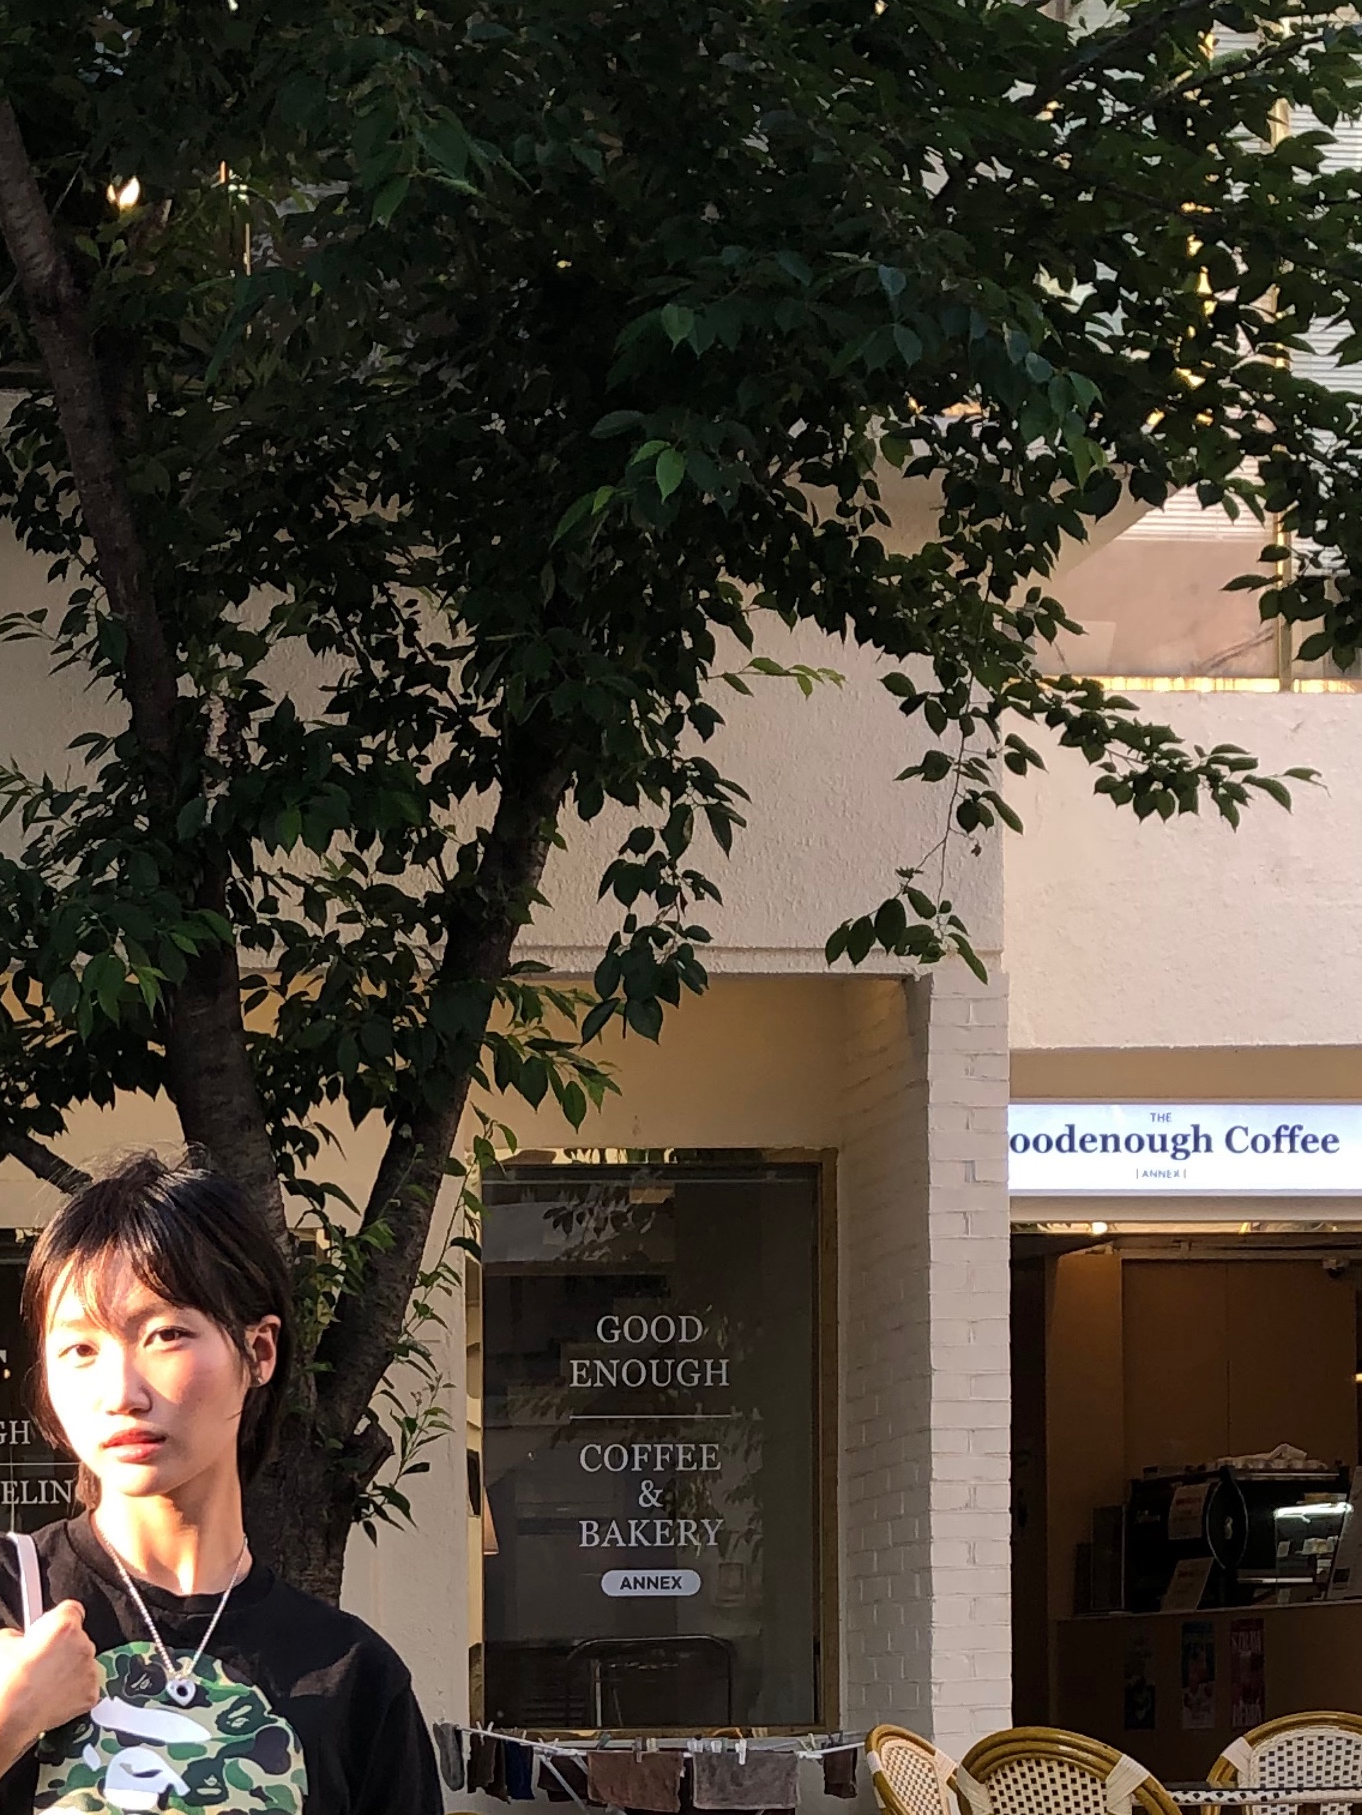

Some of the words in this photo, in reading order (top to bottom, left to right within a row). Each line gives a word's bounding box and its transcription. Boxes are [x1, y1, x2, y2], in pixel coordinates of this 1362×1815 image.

[1149, 1112, 1172, 1123] THE
[1009, 1124, 1214, 1161] oodenough
[1224, 1124, 1340, 1154] Coffee
[596, 1315, 703, 1344] GOOD
[569, 1358, 730, 1388] ENOUGH
[579, 1443, 722, 1473] COFFEE
[638, 1479, 664, 1508] &
[578, 1518, 724, 1548] BAKERY
[619, 1575, 682, 1591] ANNEX
